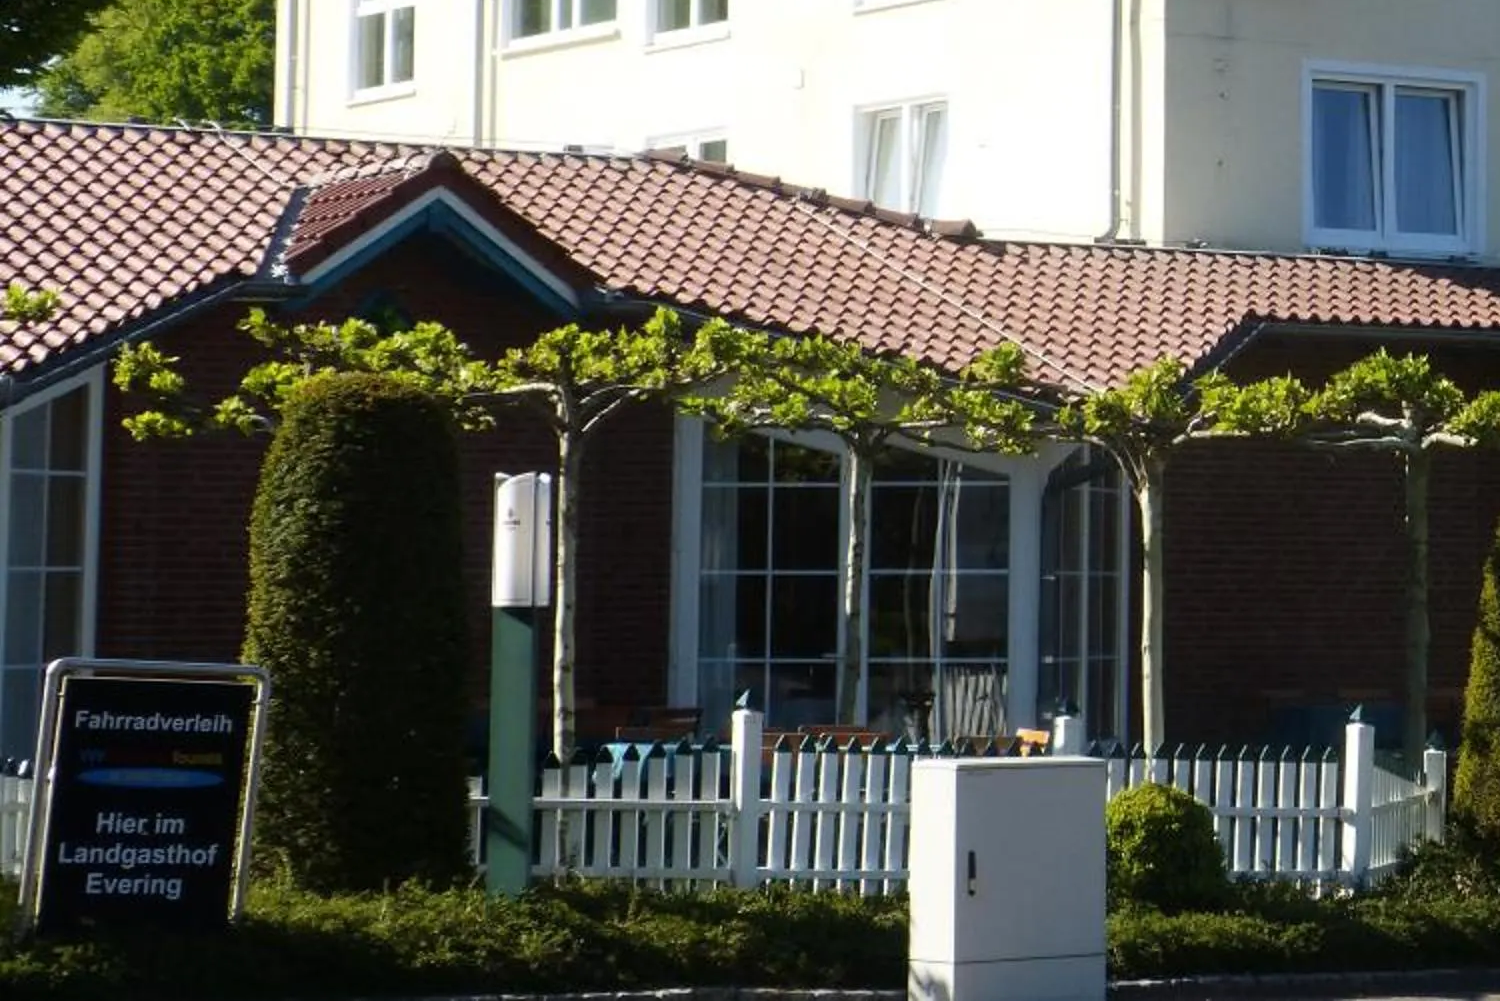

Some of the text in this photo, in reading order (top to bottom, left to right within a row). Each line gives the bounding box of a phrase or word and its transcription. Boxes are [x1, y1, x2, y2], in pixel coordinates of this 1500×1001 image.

[75, 710, 233, 733] Fahrradverleih
[96, 812, 184, 834] Hier im
[58, 843, 219, 868] Landgasthof
[86, 873, 183, 899] Evering
